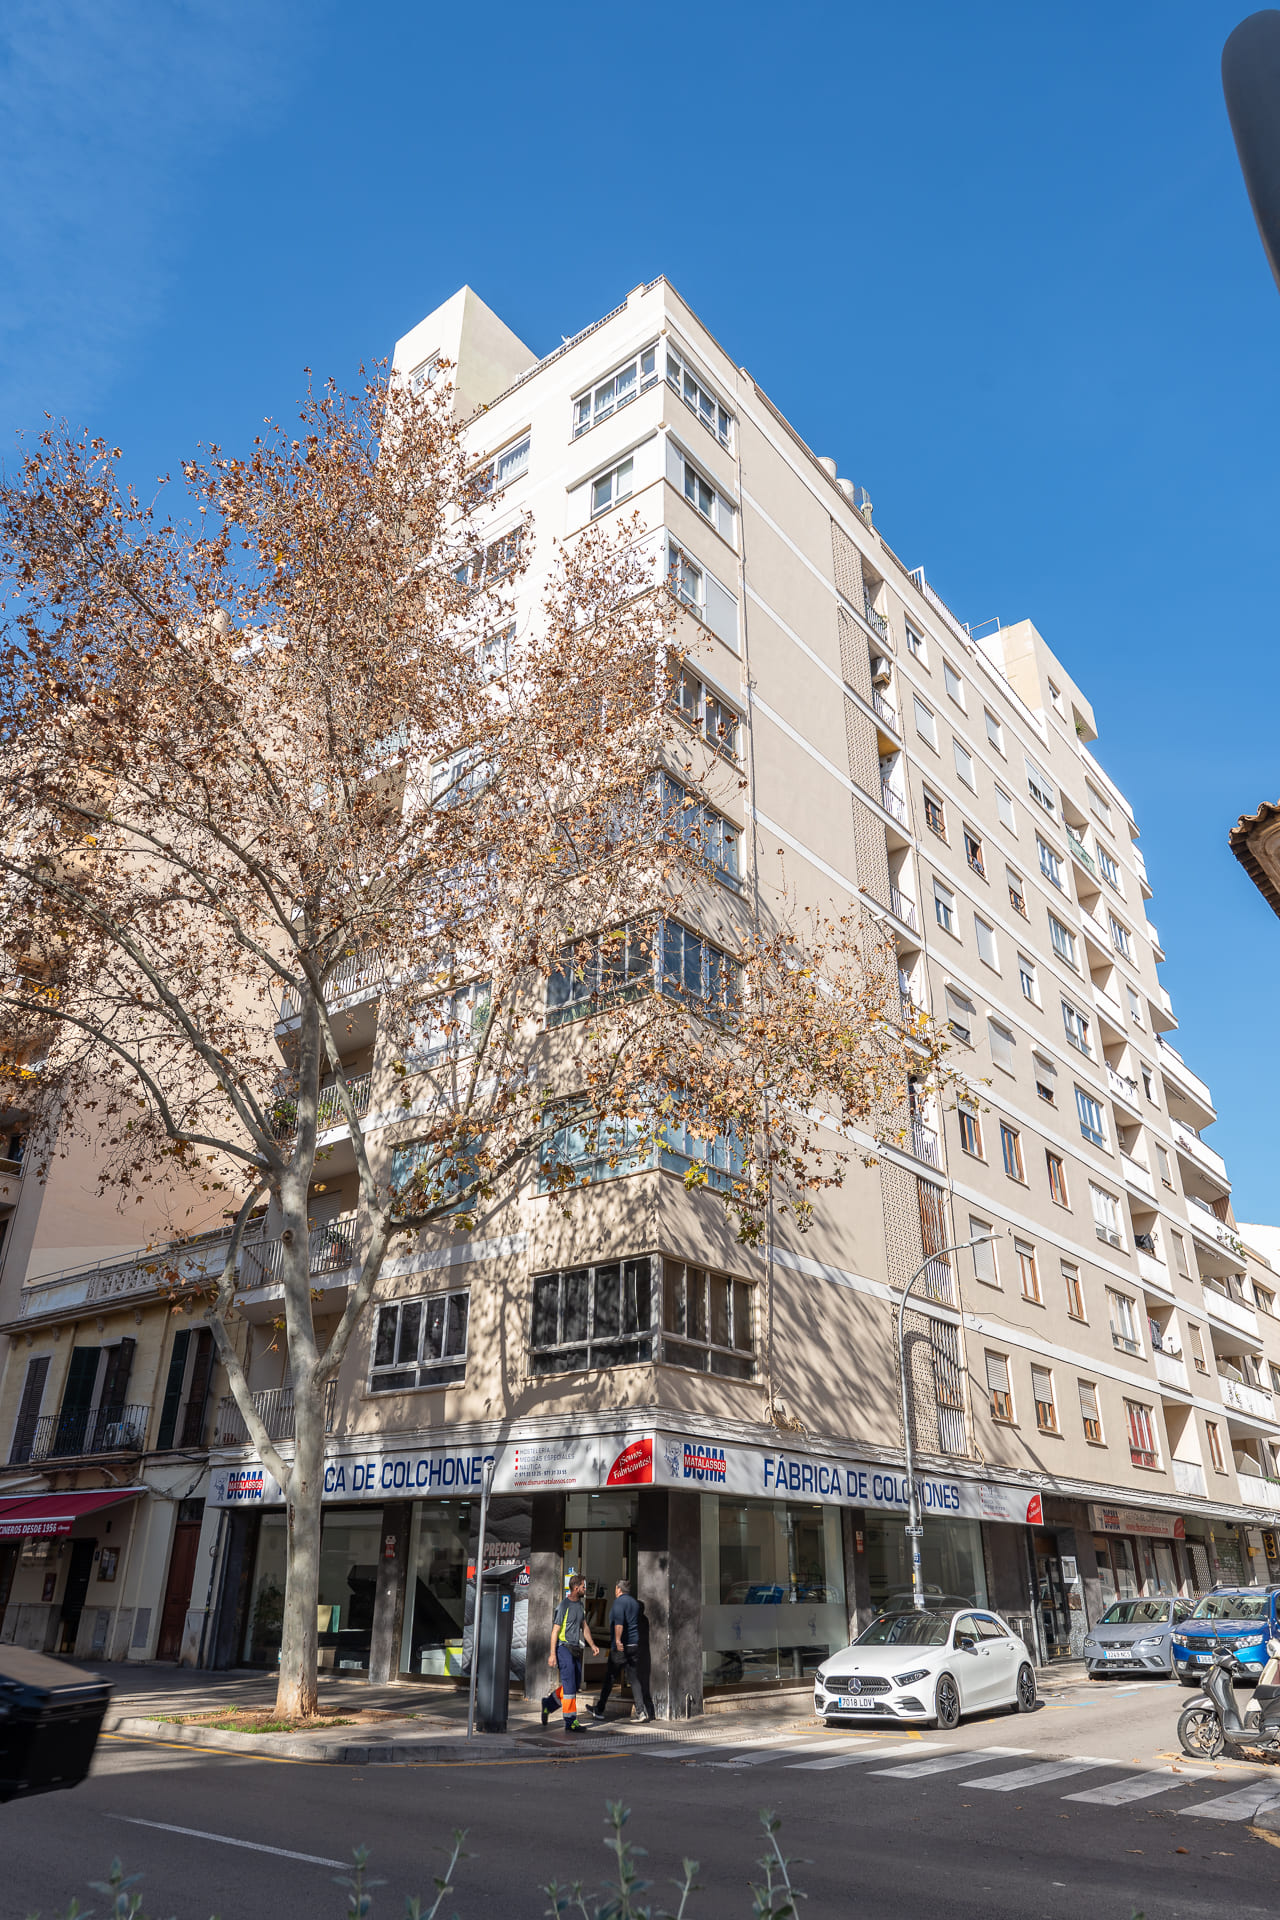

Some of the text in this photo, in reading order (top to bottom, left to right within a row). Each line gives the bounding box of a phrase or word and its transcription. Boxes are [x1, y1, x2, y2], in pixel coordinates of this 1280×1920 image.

[544, 1453, 575, 1461] ESPECIALES
[684, 1456, 726, 1471] MATALASSOS
[352, 1464, 376, 1491] DE
[381, 1455, 495, 1489] COLCHONE
[613, 1456, 651, 1480] Fabricantes!
[764, 1454, 842, 1496] FÁBRICA
[847, 1470, 868, 1499] DE
[228, 1480, 263, 1490] MATALASSOS
[22, 1524, 41, 1534] DESDE
[42, 1523, 57, 1532] 1956
[484, 1542, 521, 1557] PRECIOS
[502, 1596, 509, 1608] P
[842, 1698, 872, 1707] 7018 LDV
